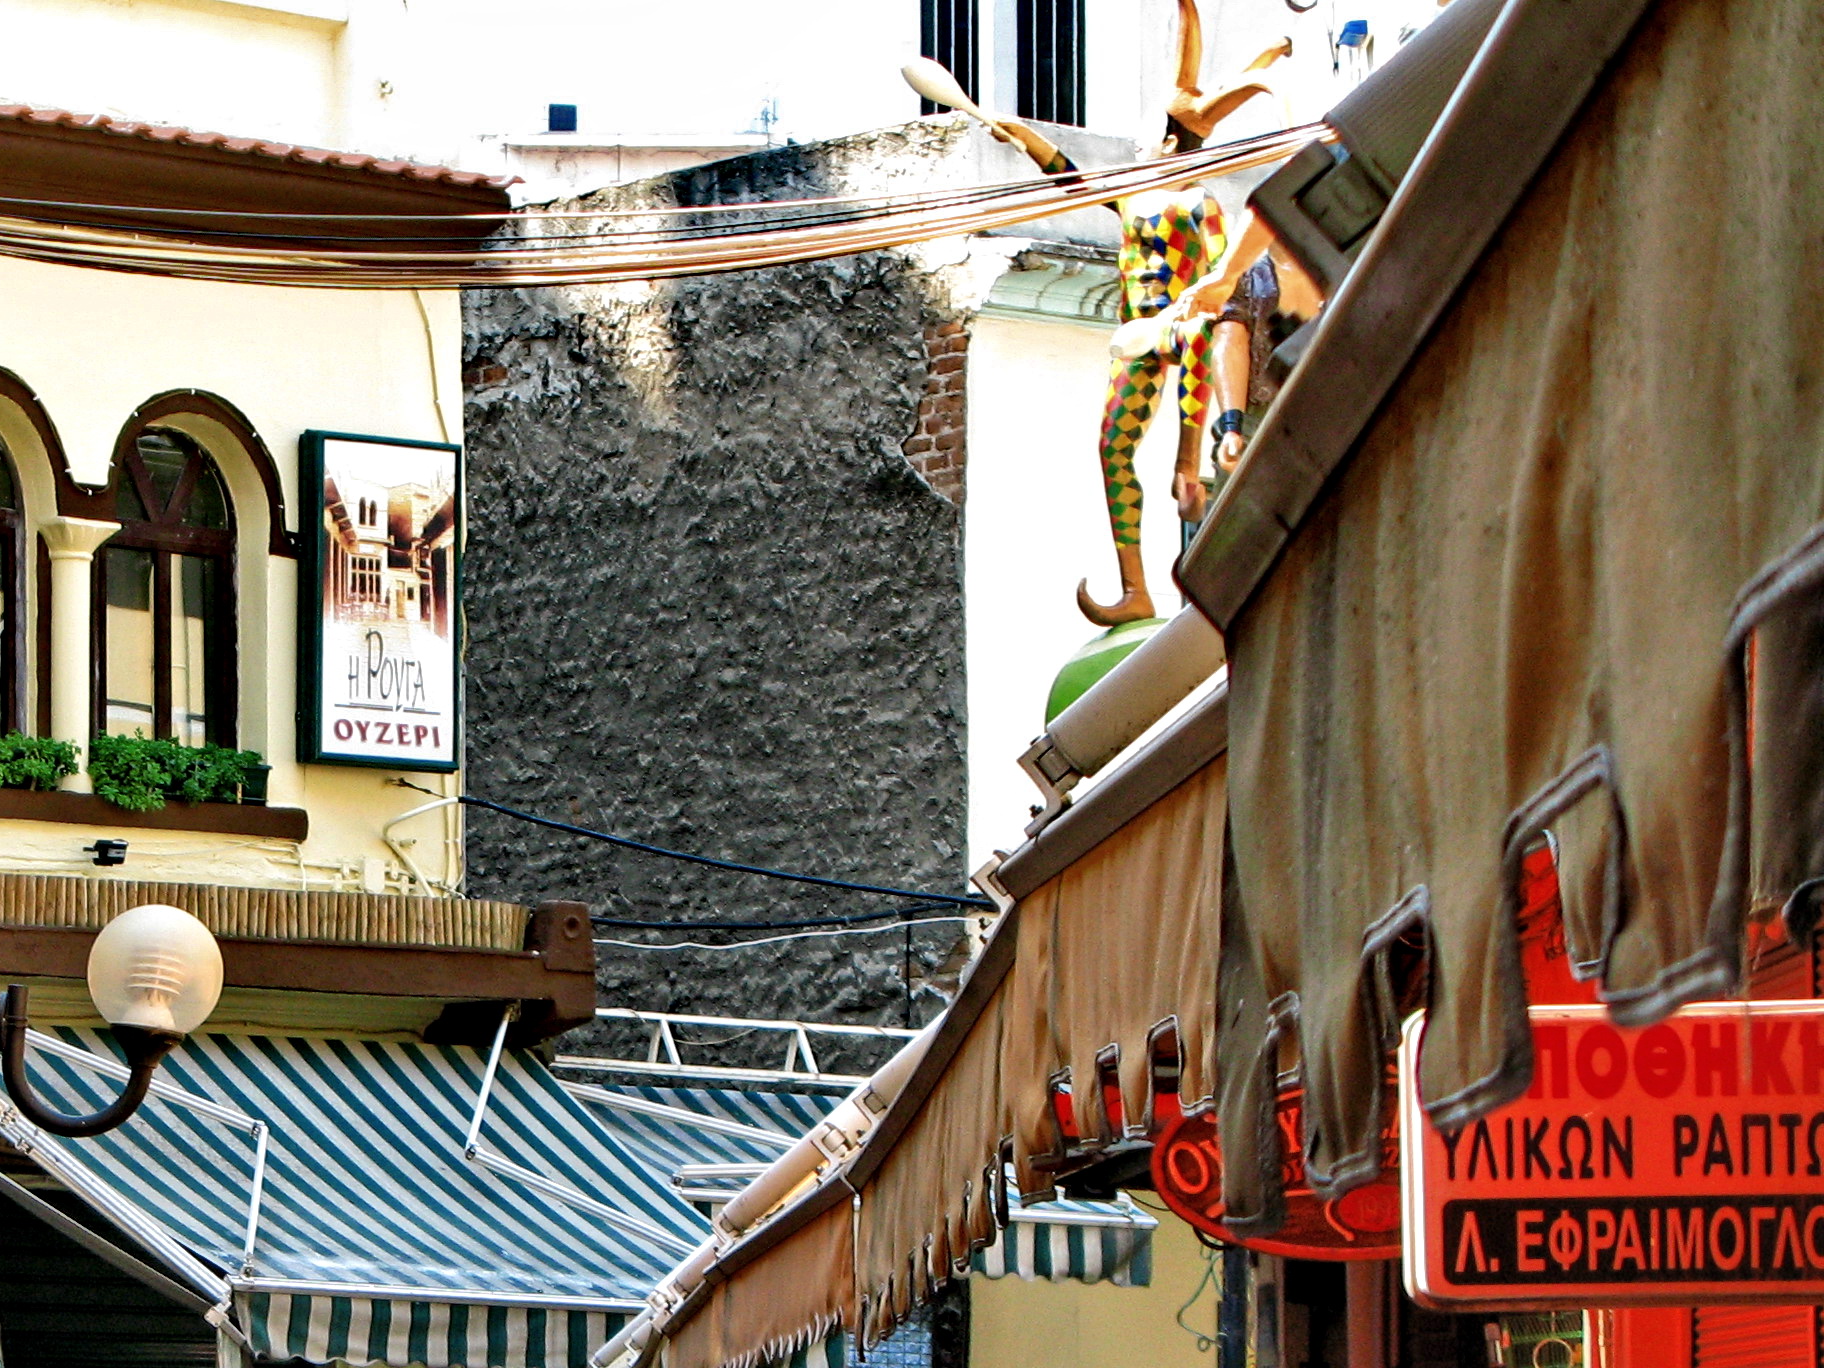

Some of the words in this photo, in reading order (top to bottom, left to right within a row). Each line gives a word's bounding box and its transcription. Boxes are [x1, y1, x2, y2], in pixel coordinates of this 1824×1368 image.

[333, 718, 441, 748] ΟΥΖΕΡΙ
[1438, 1113, 1634, 1181] ΥΛΙΚΩΝ
[1455, 1210, 1500, 1273] Λ.
